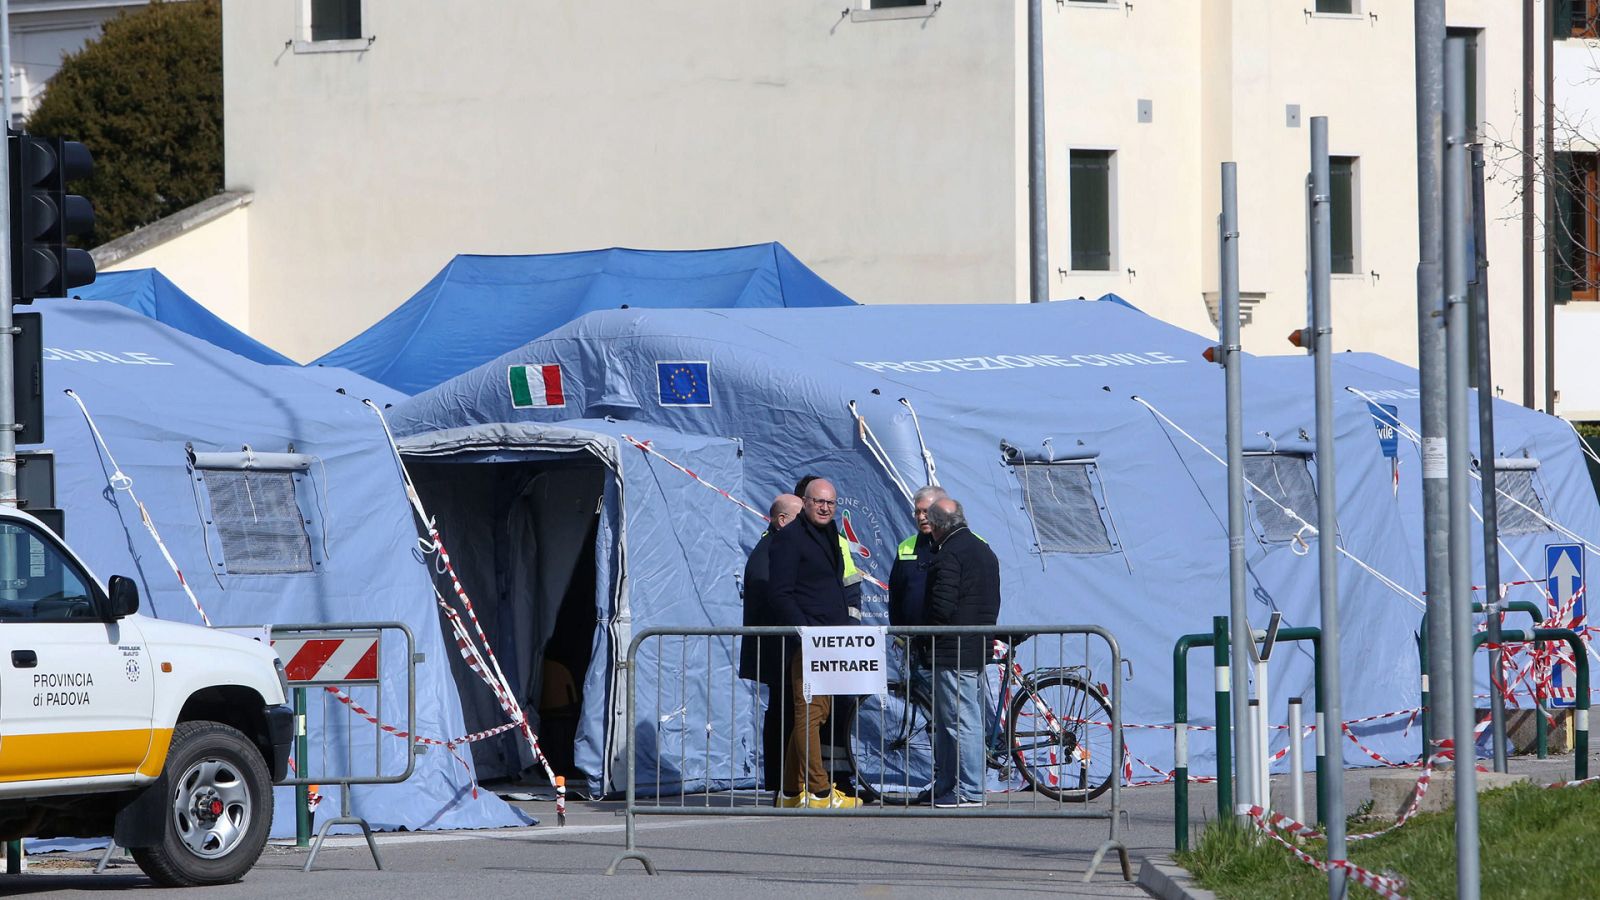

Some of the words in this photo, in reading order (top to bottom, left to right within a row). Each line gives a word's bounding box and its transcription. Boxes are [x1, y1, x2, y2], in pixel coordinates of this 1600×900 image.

[853, 354, 1072, 373] PROTEZIONE
[1073, 351, 1188, 367] CIVILE
[861, 506, 883, 546] CIVILE
[812, 636, 875, 648] VIETATO
[810, 660, 879, 672] ENTRARE
[33, 673, 94, 687] PROVINCIA
[33, 692, 43, 707] di
[46, 691, 90, 706] PADOVA
